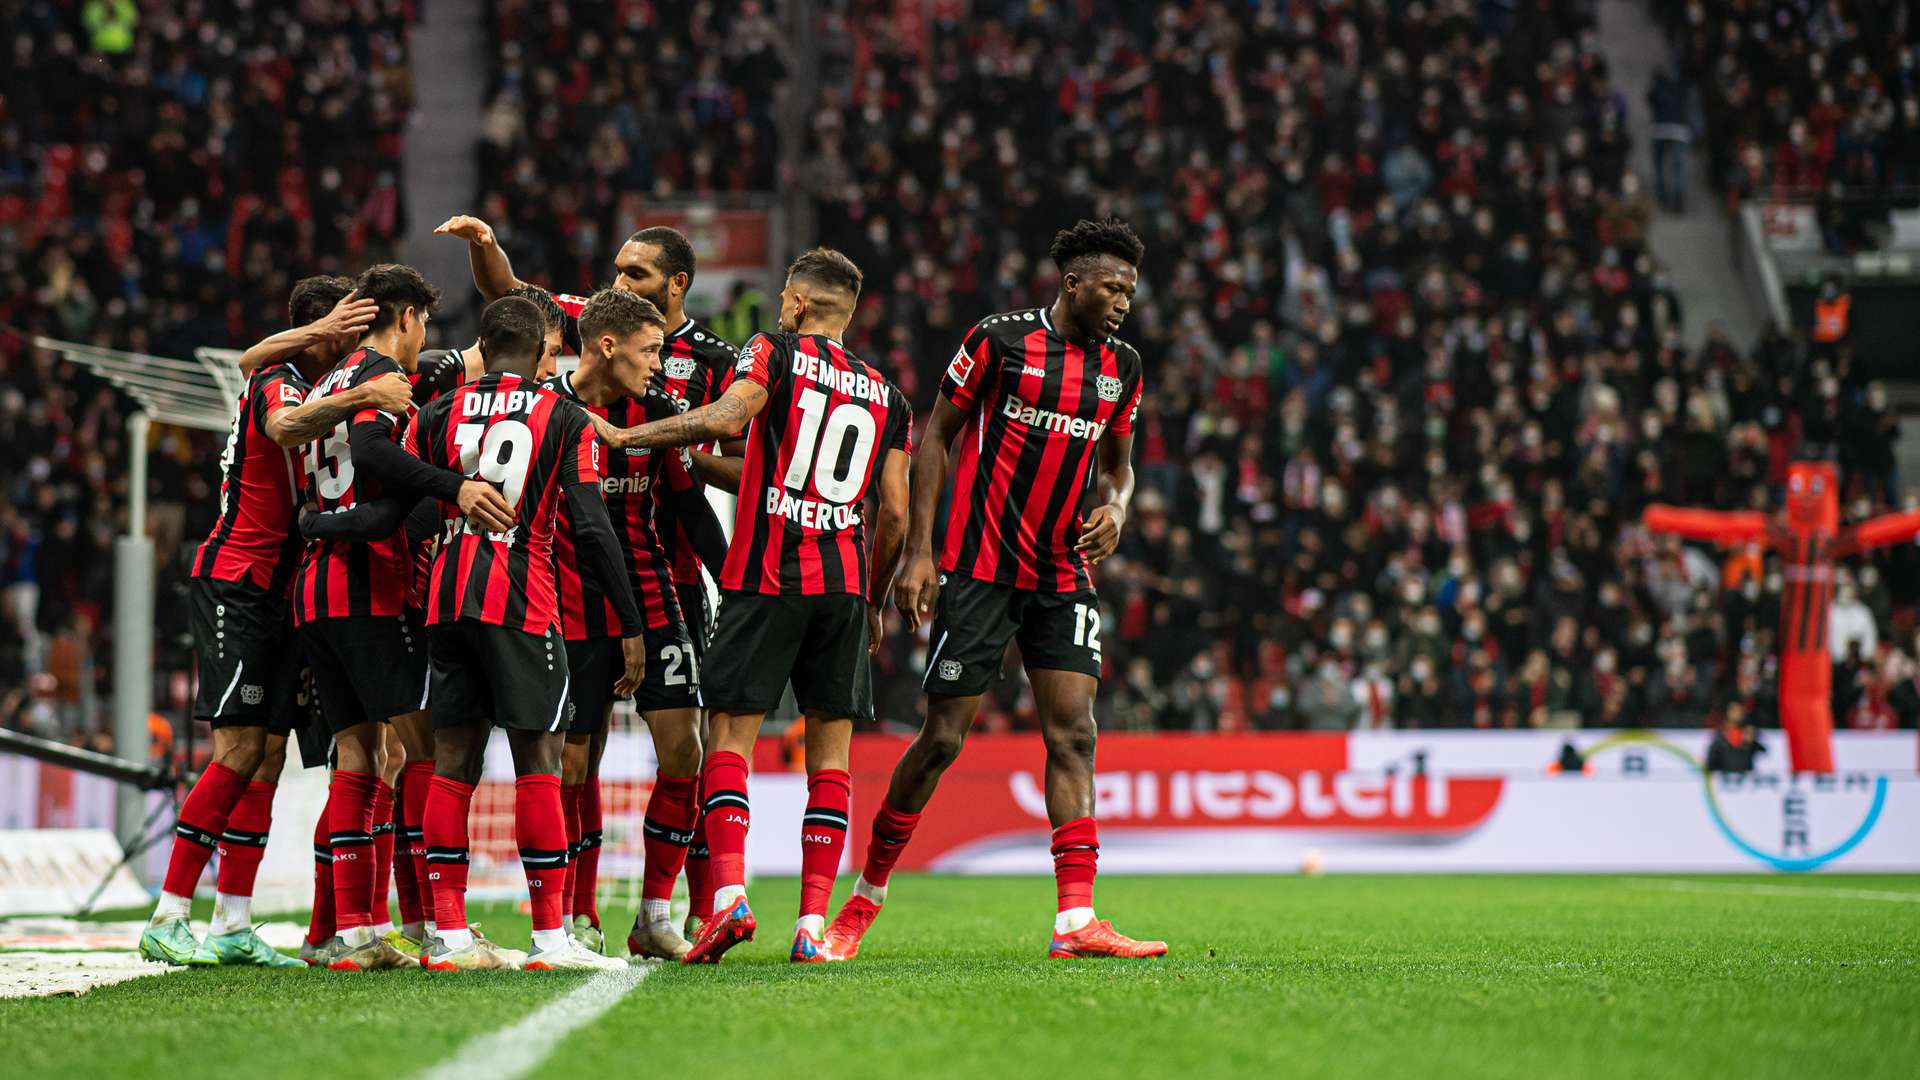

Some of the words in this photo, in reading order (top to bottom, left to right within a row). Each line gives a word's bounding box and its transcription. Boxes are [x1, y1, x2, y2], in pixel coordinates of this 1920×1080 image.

[792, 350, 890, 408] DEMIRBAY
[1022, 365, 1046, 378] JAKO
[462, 391, 543, 417] DIABY
[1003, 394, 1107, 442] Barmeni
[784, 387, 876, 503] 10
[1073, 603, 1101, 653] 12
[660, 643, 698, 686] 21
[725, 813, 749, 827] JAK
